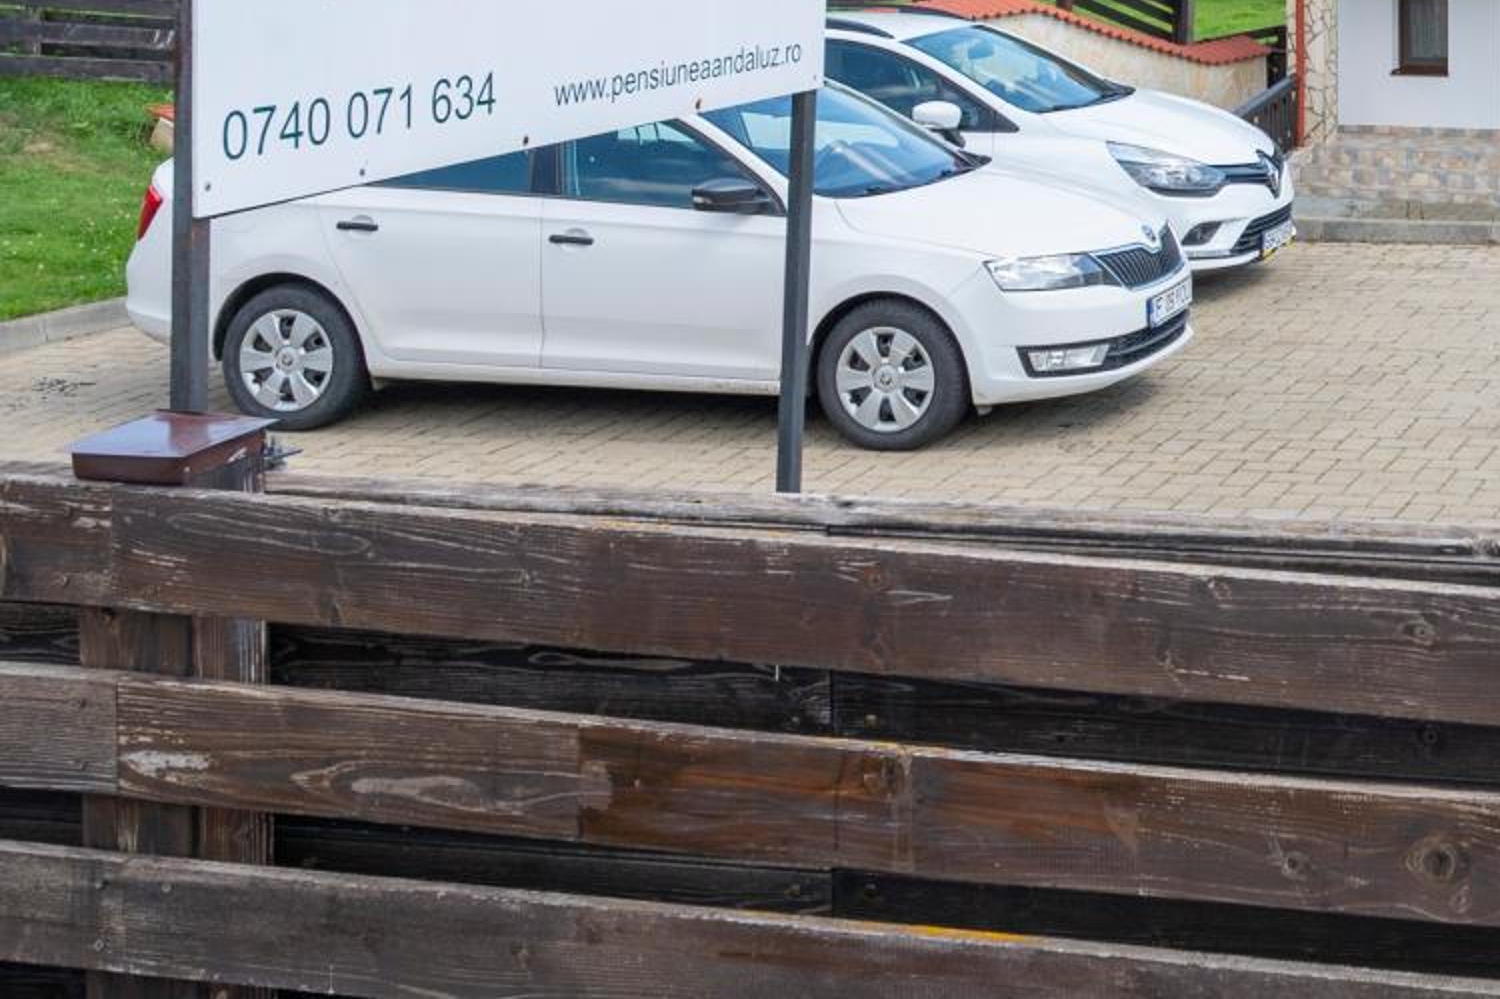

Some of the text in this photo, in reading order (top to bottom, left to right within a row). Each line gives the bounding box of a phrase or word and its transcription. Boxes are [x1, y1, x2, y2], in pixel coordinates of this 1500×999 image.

[554, 42, 802, 106] www.pensiuneaandaluz.ro
[222, 72, 498, 161] 0740 071 634
